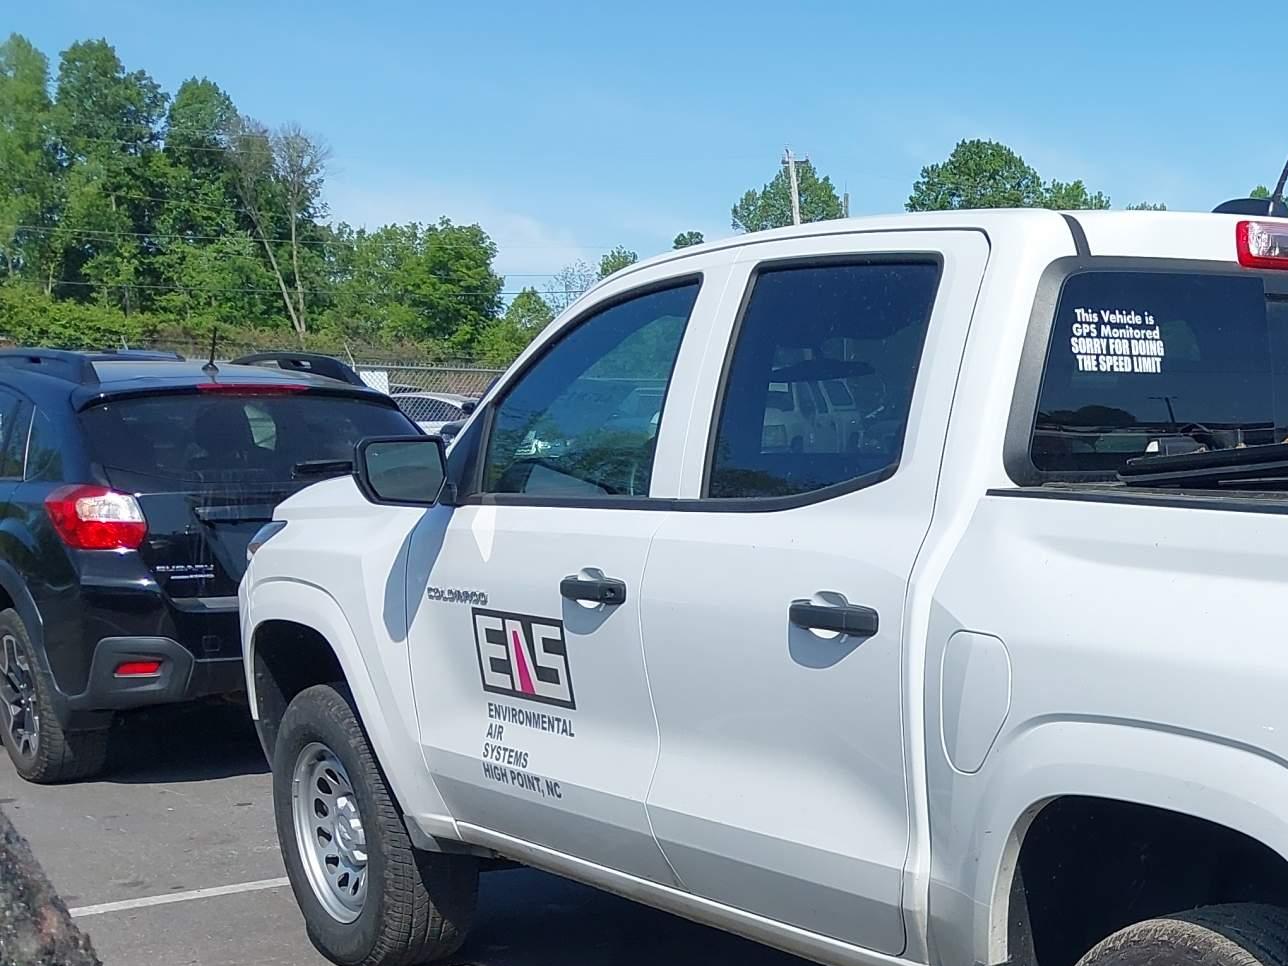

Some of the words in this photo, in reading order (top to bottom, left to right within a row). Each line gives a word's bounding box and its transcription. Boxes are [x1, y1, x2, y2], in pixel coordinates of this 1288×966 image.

[1074, 308, 1098, 322] This
[1100, 310, 1142, 325] Vehicle
[1144, 311, 1155, 325] is
[1072, 323, 1097, 337] GPS
[1100, 325, 1160, 339] Monitored
[1070, 337, 1107, 354] SORRY
[1109, 338, 1130, 355] FOR
[1131, 340, 1165, 356] DOING
[1076, 355, 1098, 371] THE
[1099, 355, 1132, 372] SPEED
[1133, 357, 1162, 373] LIMIT
[427, 587, 489, 606] COLORADO
[487, 702, 575, 737] ENVIRONMENTAL
[486, 723, 504, 741] AIR
[482, 742, 529, 769] SYSTEMS
[483, 762, 508, 785] HIGH
[510, 769, 545, 798] POINT,
[546, 780, 562, 799] NC
